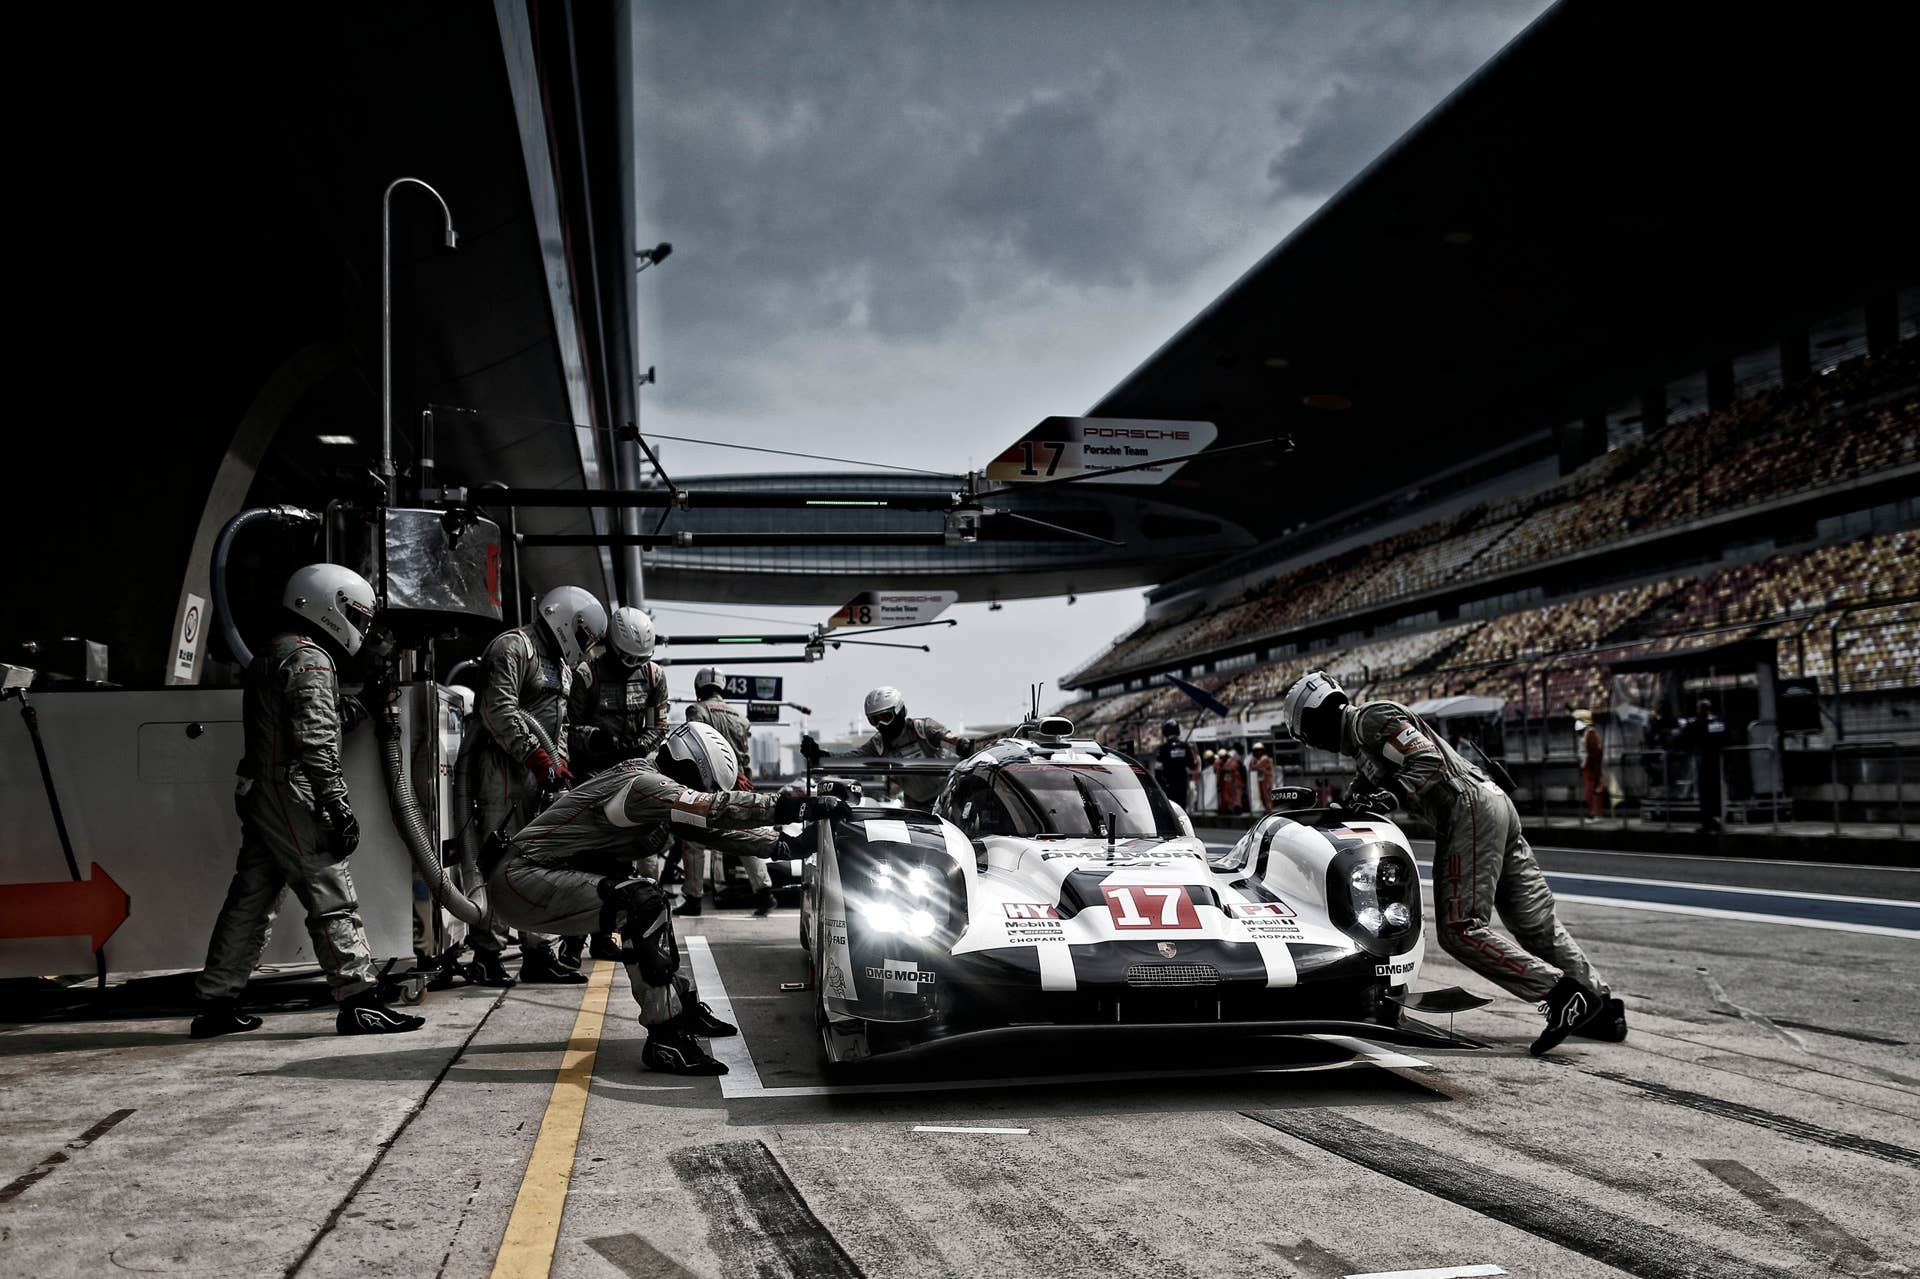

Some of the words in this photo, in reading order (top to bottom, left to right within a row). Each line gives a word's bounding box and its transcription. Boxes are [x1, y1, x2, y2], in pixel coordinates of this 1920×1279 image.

[1083, 428, 1190, 440] PORSCHE
[1084, 445, 1122, 456] Porsche
[1125, 446, 1148, 456] Team
[1020, 441, 1065, 476] 17
[847, 606, 872, 625] 18
[321, 616, 342, 632] uvex
[726, 677, 748, 695] 43
[1004, 904, 1050, 918] HY
[1107, 887, 1181, 926] 17
[1240, 904, 1285, 915] P1
[832, 935, 846, 945] FAG
[866, 968, 892, 979] DMG
[895, 970, 935, 983] MORI
[1376, 965, 1402, 975] DMG
